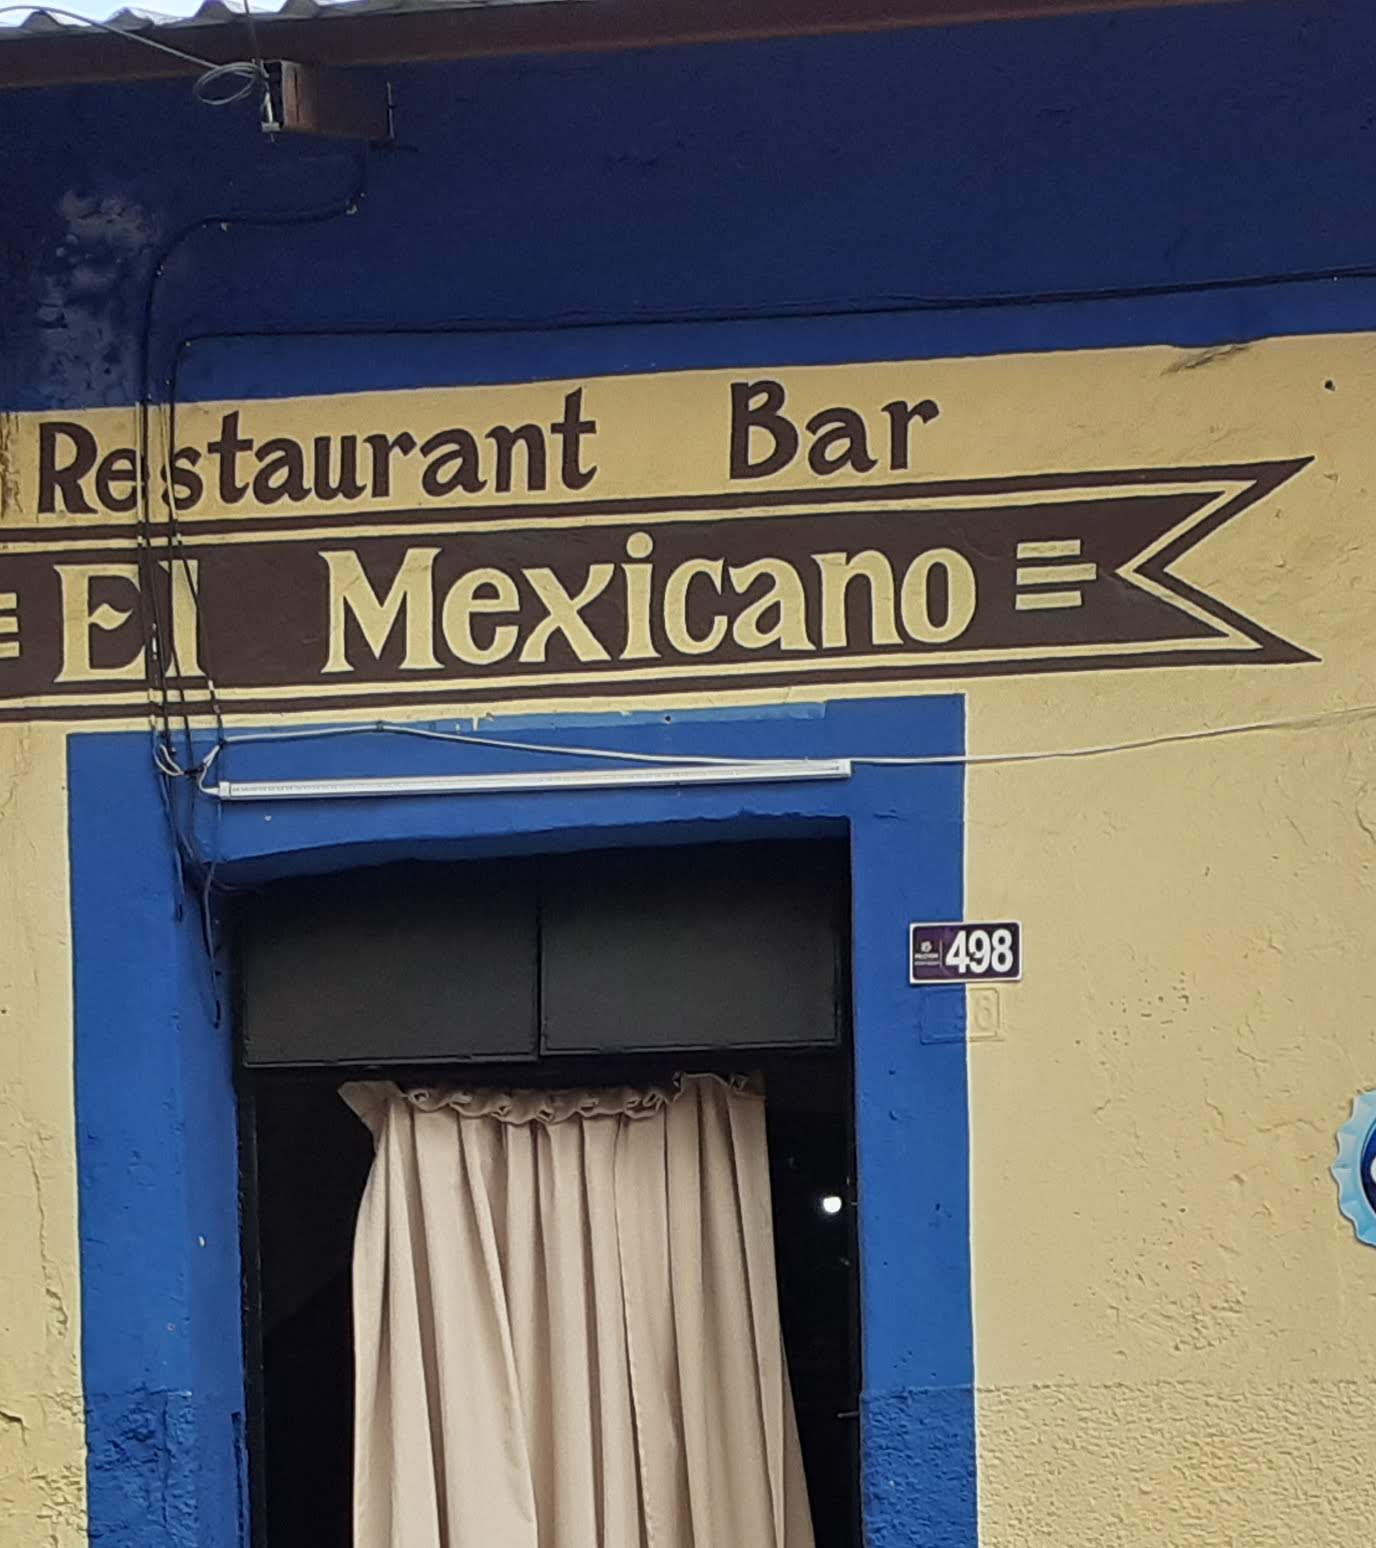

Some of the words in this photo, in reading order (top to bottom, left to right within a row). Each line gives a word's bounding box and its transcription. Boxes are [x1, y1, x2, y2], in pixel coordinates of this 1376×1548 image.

[38, 388, 598, 515] Restaurant
[728, 379, 941, 482] Bar
[53, 558, 209, 684] El
[320, 532, 977, 675] Mexicano
[945, 928, 1014, 974] 498
